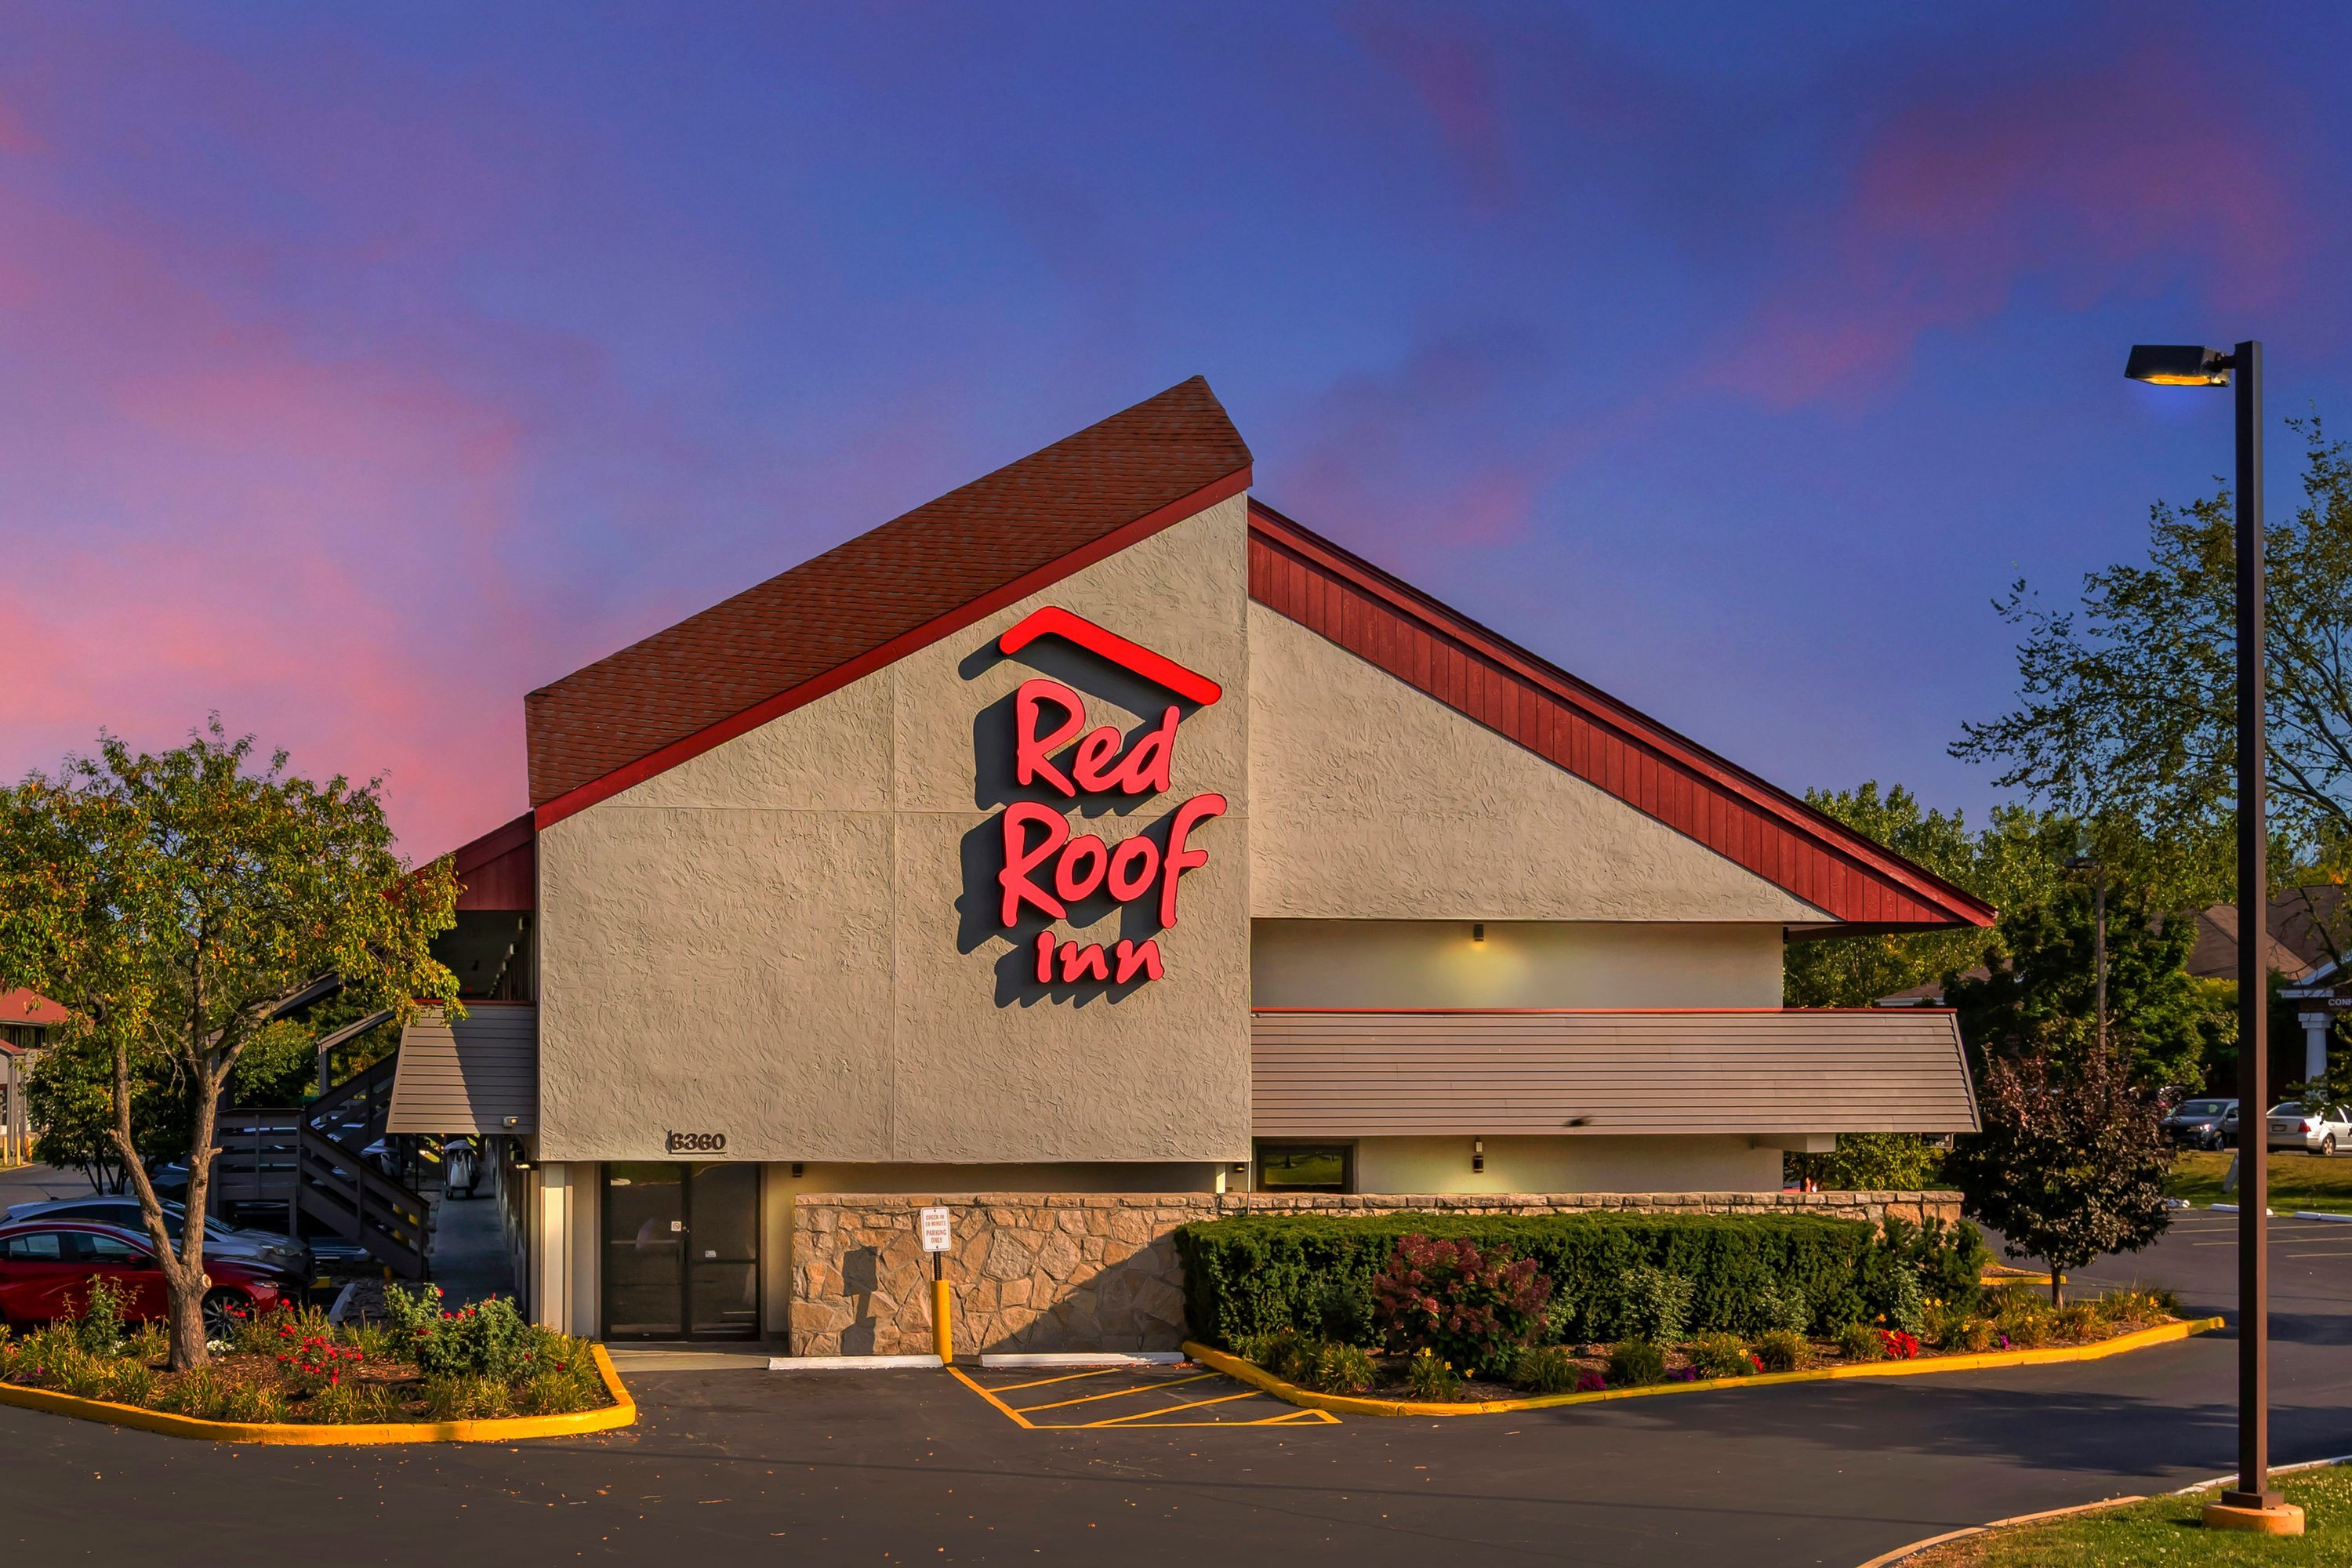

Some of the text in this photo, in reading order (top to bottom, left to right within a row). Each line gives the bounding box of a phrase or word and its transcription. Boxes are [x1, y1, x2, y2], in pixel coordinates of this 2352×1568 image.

[1016, 677, 1181, 798] Red
[997, 793, 1227, 930] Roof
[1035, 930, 1165, 985] Inn
[671, 1133, 726, 1150] 6360
